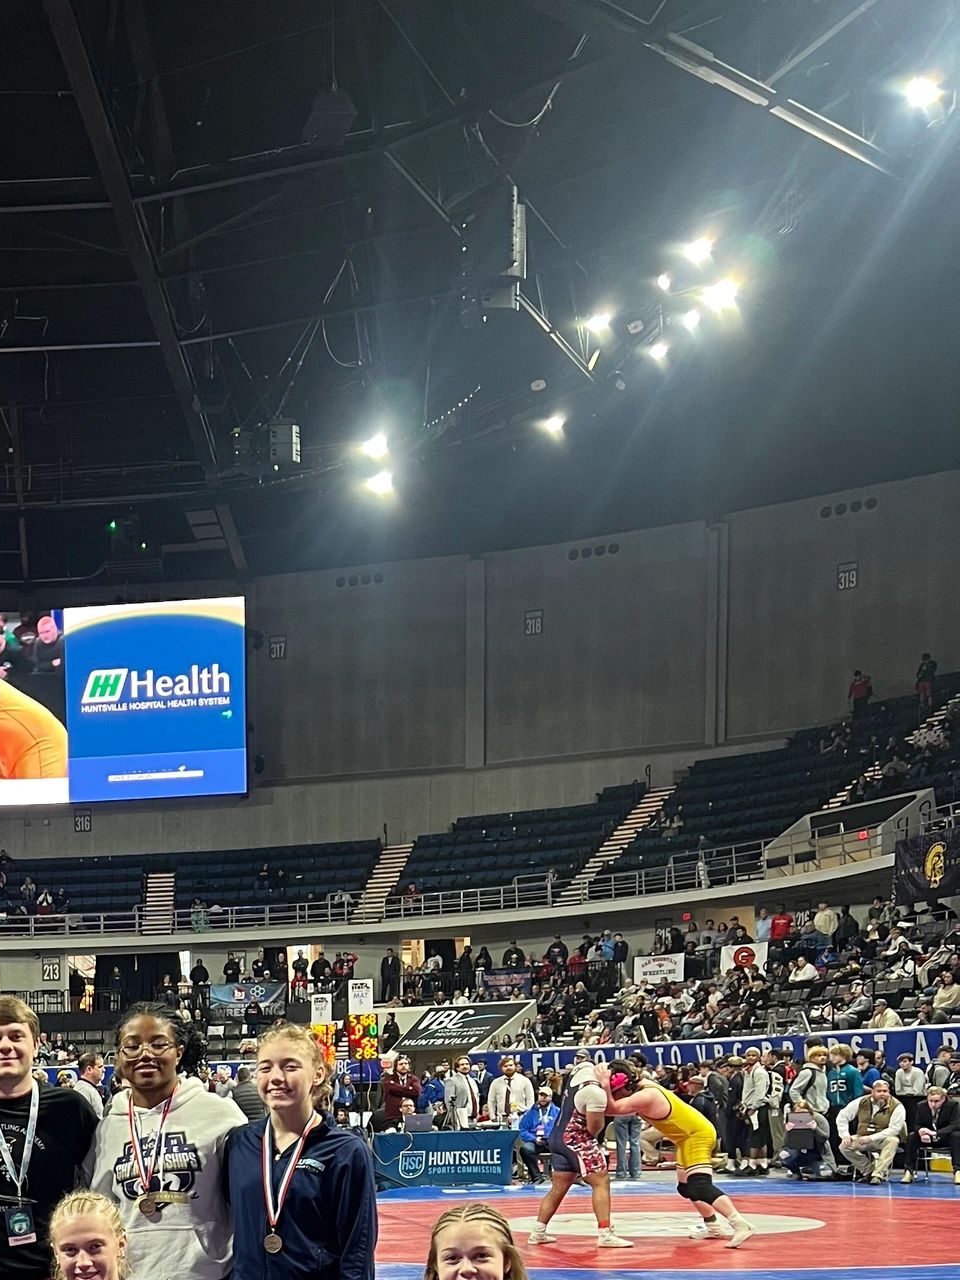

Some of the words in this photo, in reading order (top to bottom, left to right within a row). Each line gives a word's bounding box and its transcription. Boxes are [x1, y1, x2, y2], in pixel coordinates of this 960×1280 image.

[838, 571, 857, 589] 319
[525, 618, 542, 634] 318
[271, 642, 285, 658] 317
[130, 663, 230, 698] Health
[81, 703, 128, 713] HUNTSVILLE
[129, 700, 167, 711] HOSPITAL
[168, 697, 197, 708] HEALTH
[198, 696, 230, 706] SYSTEM
[75, 816, 91, 831] 316
[43, 964, 60, 980] 213
[215, 1001, 285, 1017] WRESING
[417, 1009, 476, 1030] VBC
[401, 1036, 479, 1046] HUNTSVILLE
[402, 1156, 423, 1171] HSC
[428, 1149, 501, 1166] HUNTSVILLE
[428, 1166, 455, 1174] SPORTS
[457, 1166, 502, 1174] COMMISSION
